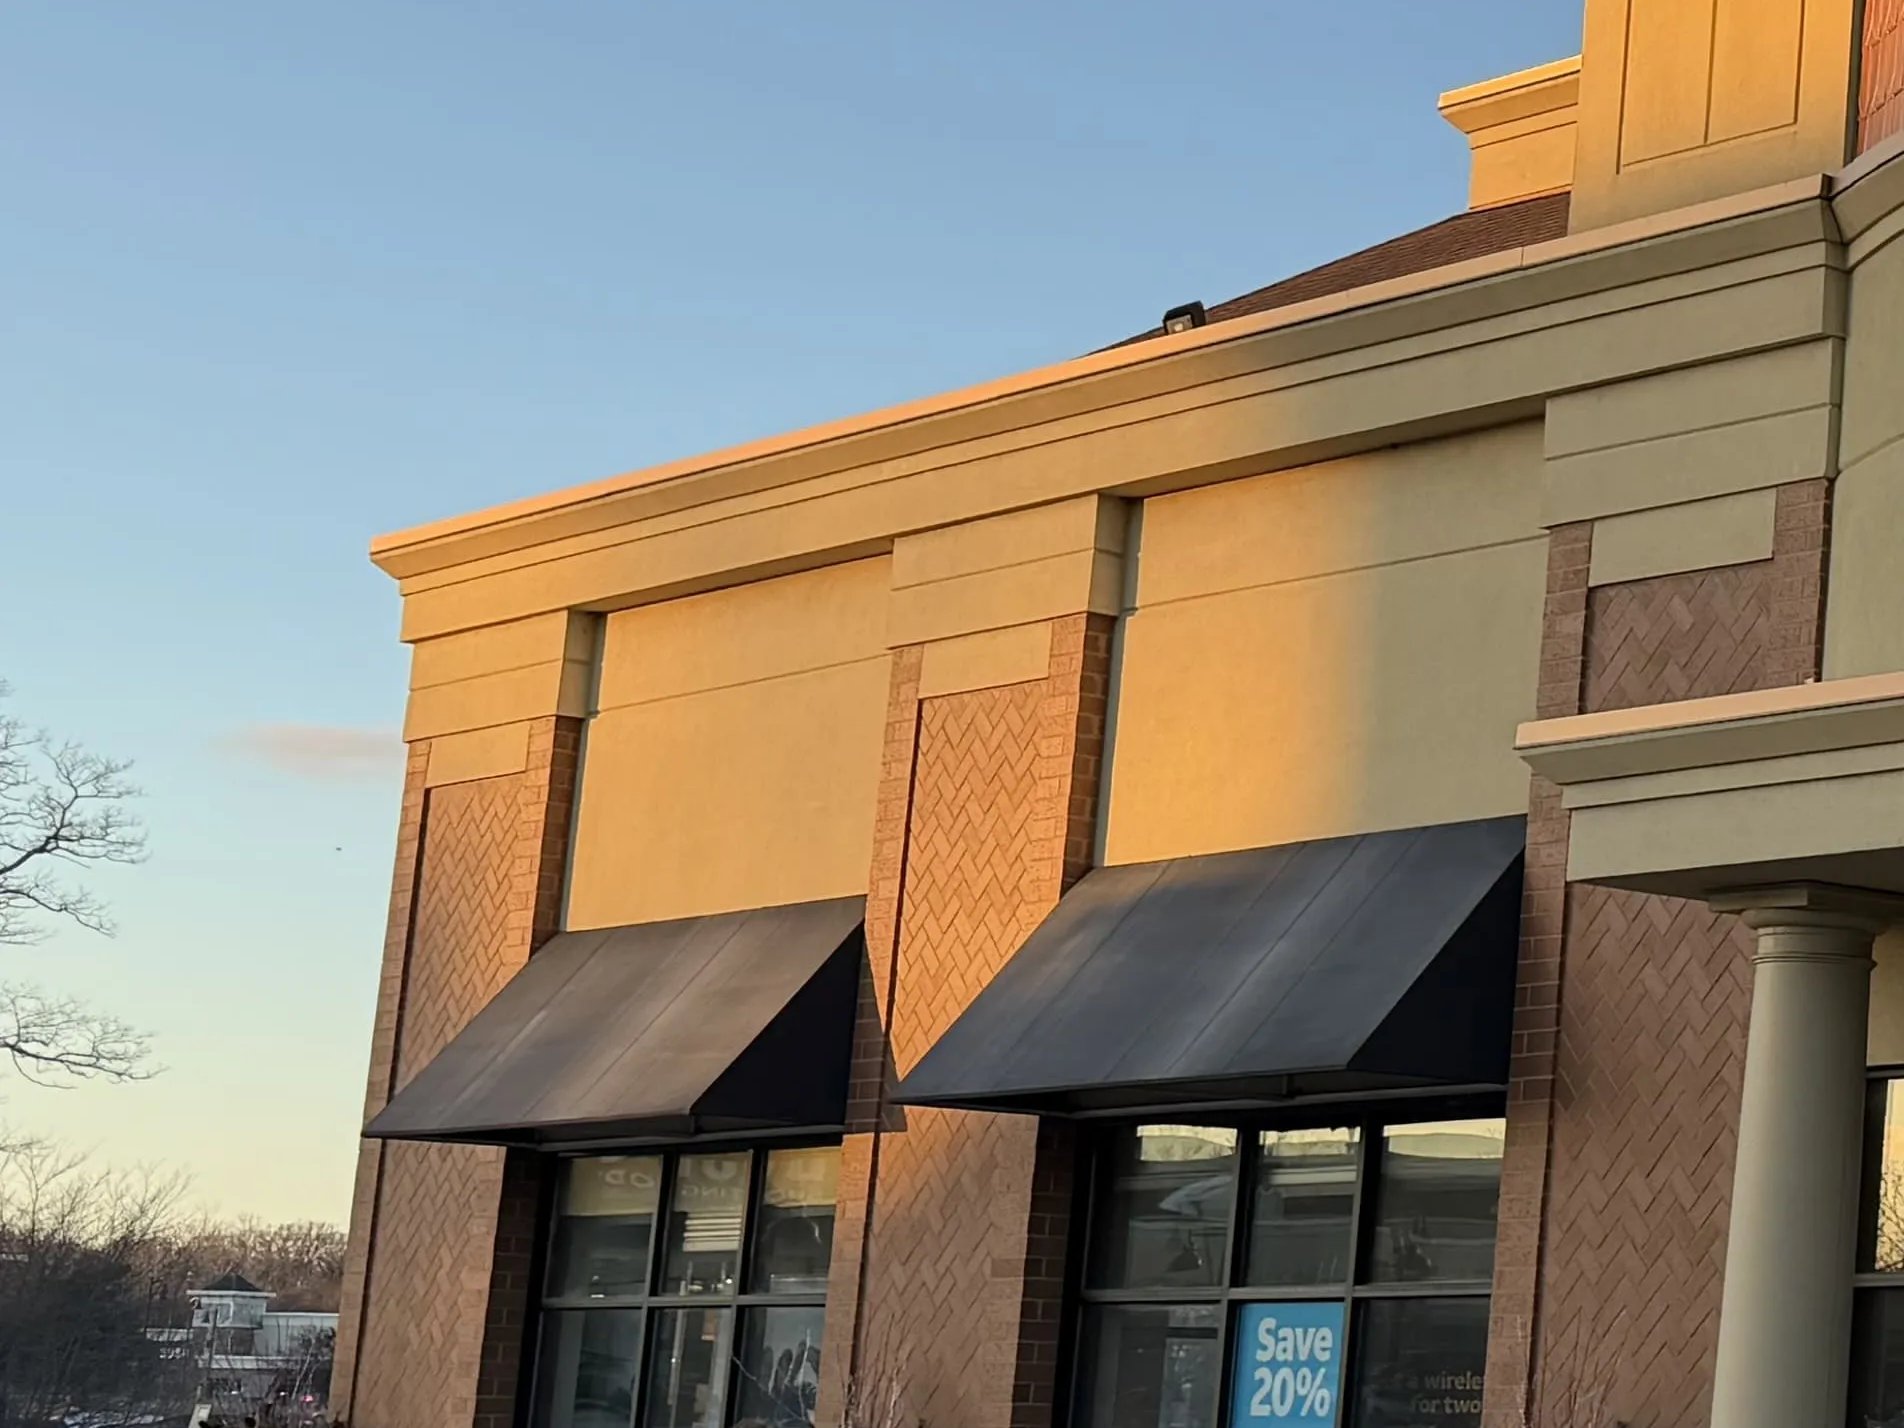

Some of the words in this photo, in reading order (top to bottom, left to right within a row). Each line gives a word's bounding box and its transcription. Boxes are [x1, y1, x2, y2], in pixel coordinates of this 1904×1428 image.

[1255, 1316, 1333, 1363] Save
[1249, 1366, 1331, 1417] 20%
[1424, 1370, 1485, 1391] wirele
[1411, 1392, 1441, 1414] for
[1443, 1396, 1482, 1414] two
